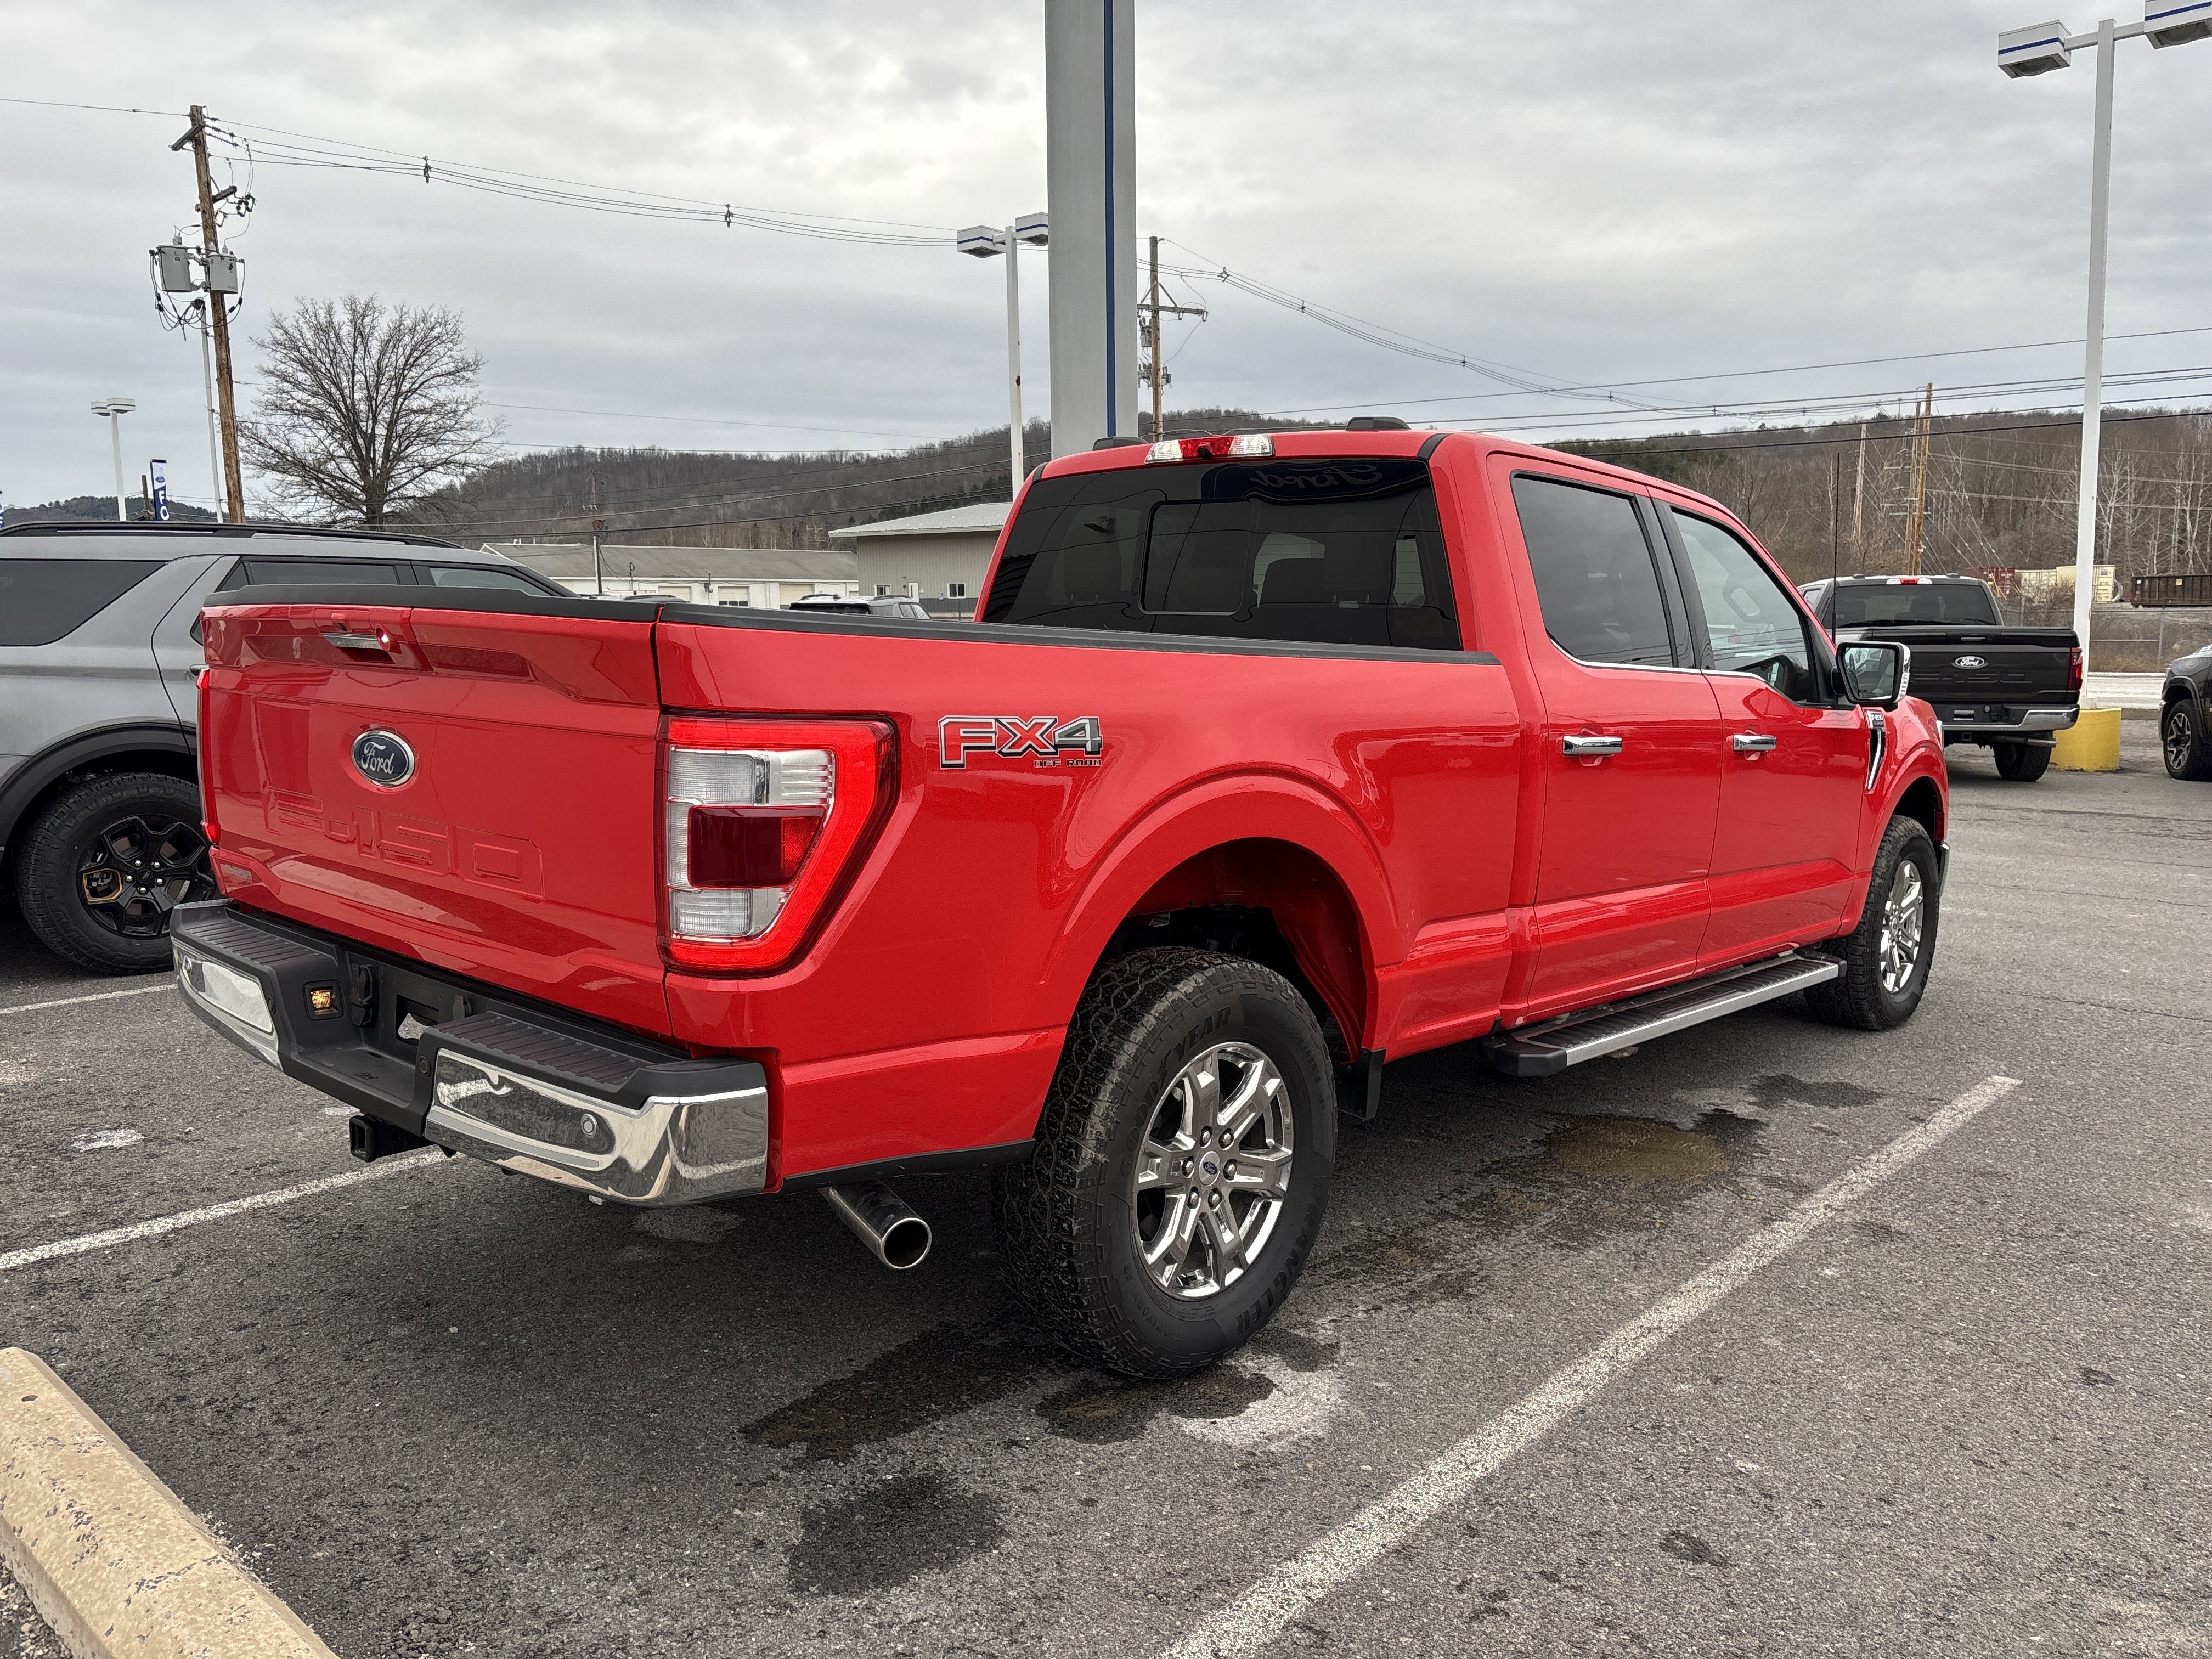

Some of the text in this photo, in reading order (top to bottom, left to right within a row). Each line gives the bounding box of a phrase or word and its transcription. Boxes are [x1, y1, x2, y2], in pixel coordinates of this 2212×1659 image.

[1960, 657, 1979, 666] Ford
[938, 715, 1104, 770] FX4
[360, 741, 395, 774] Ford
[1033, 759, 1102, 768] OFF ROAD
